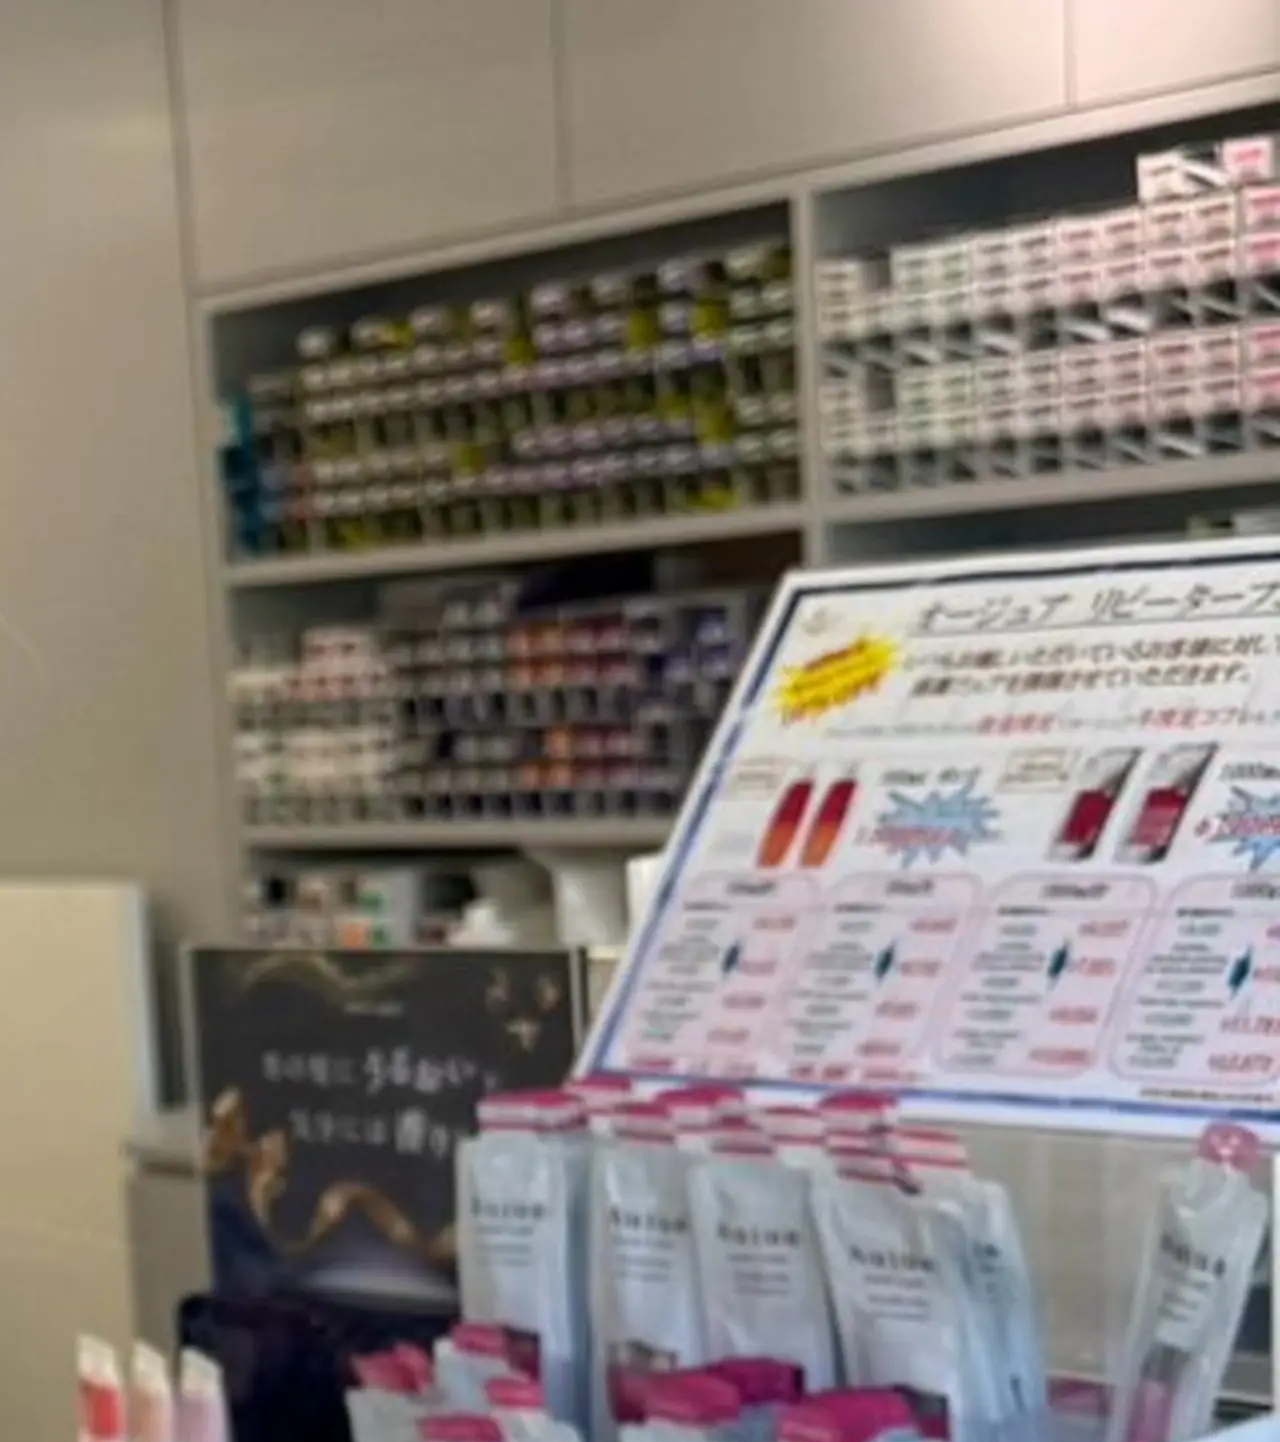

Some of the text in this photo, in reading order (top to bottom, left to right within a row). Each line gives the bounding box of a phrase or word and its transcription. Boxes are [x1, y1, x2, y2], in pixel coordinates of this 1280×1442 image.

[918, 591, 1073, 632] オージュア
